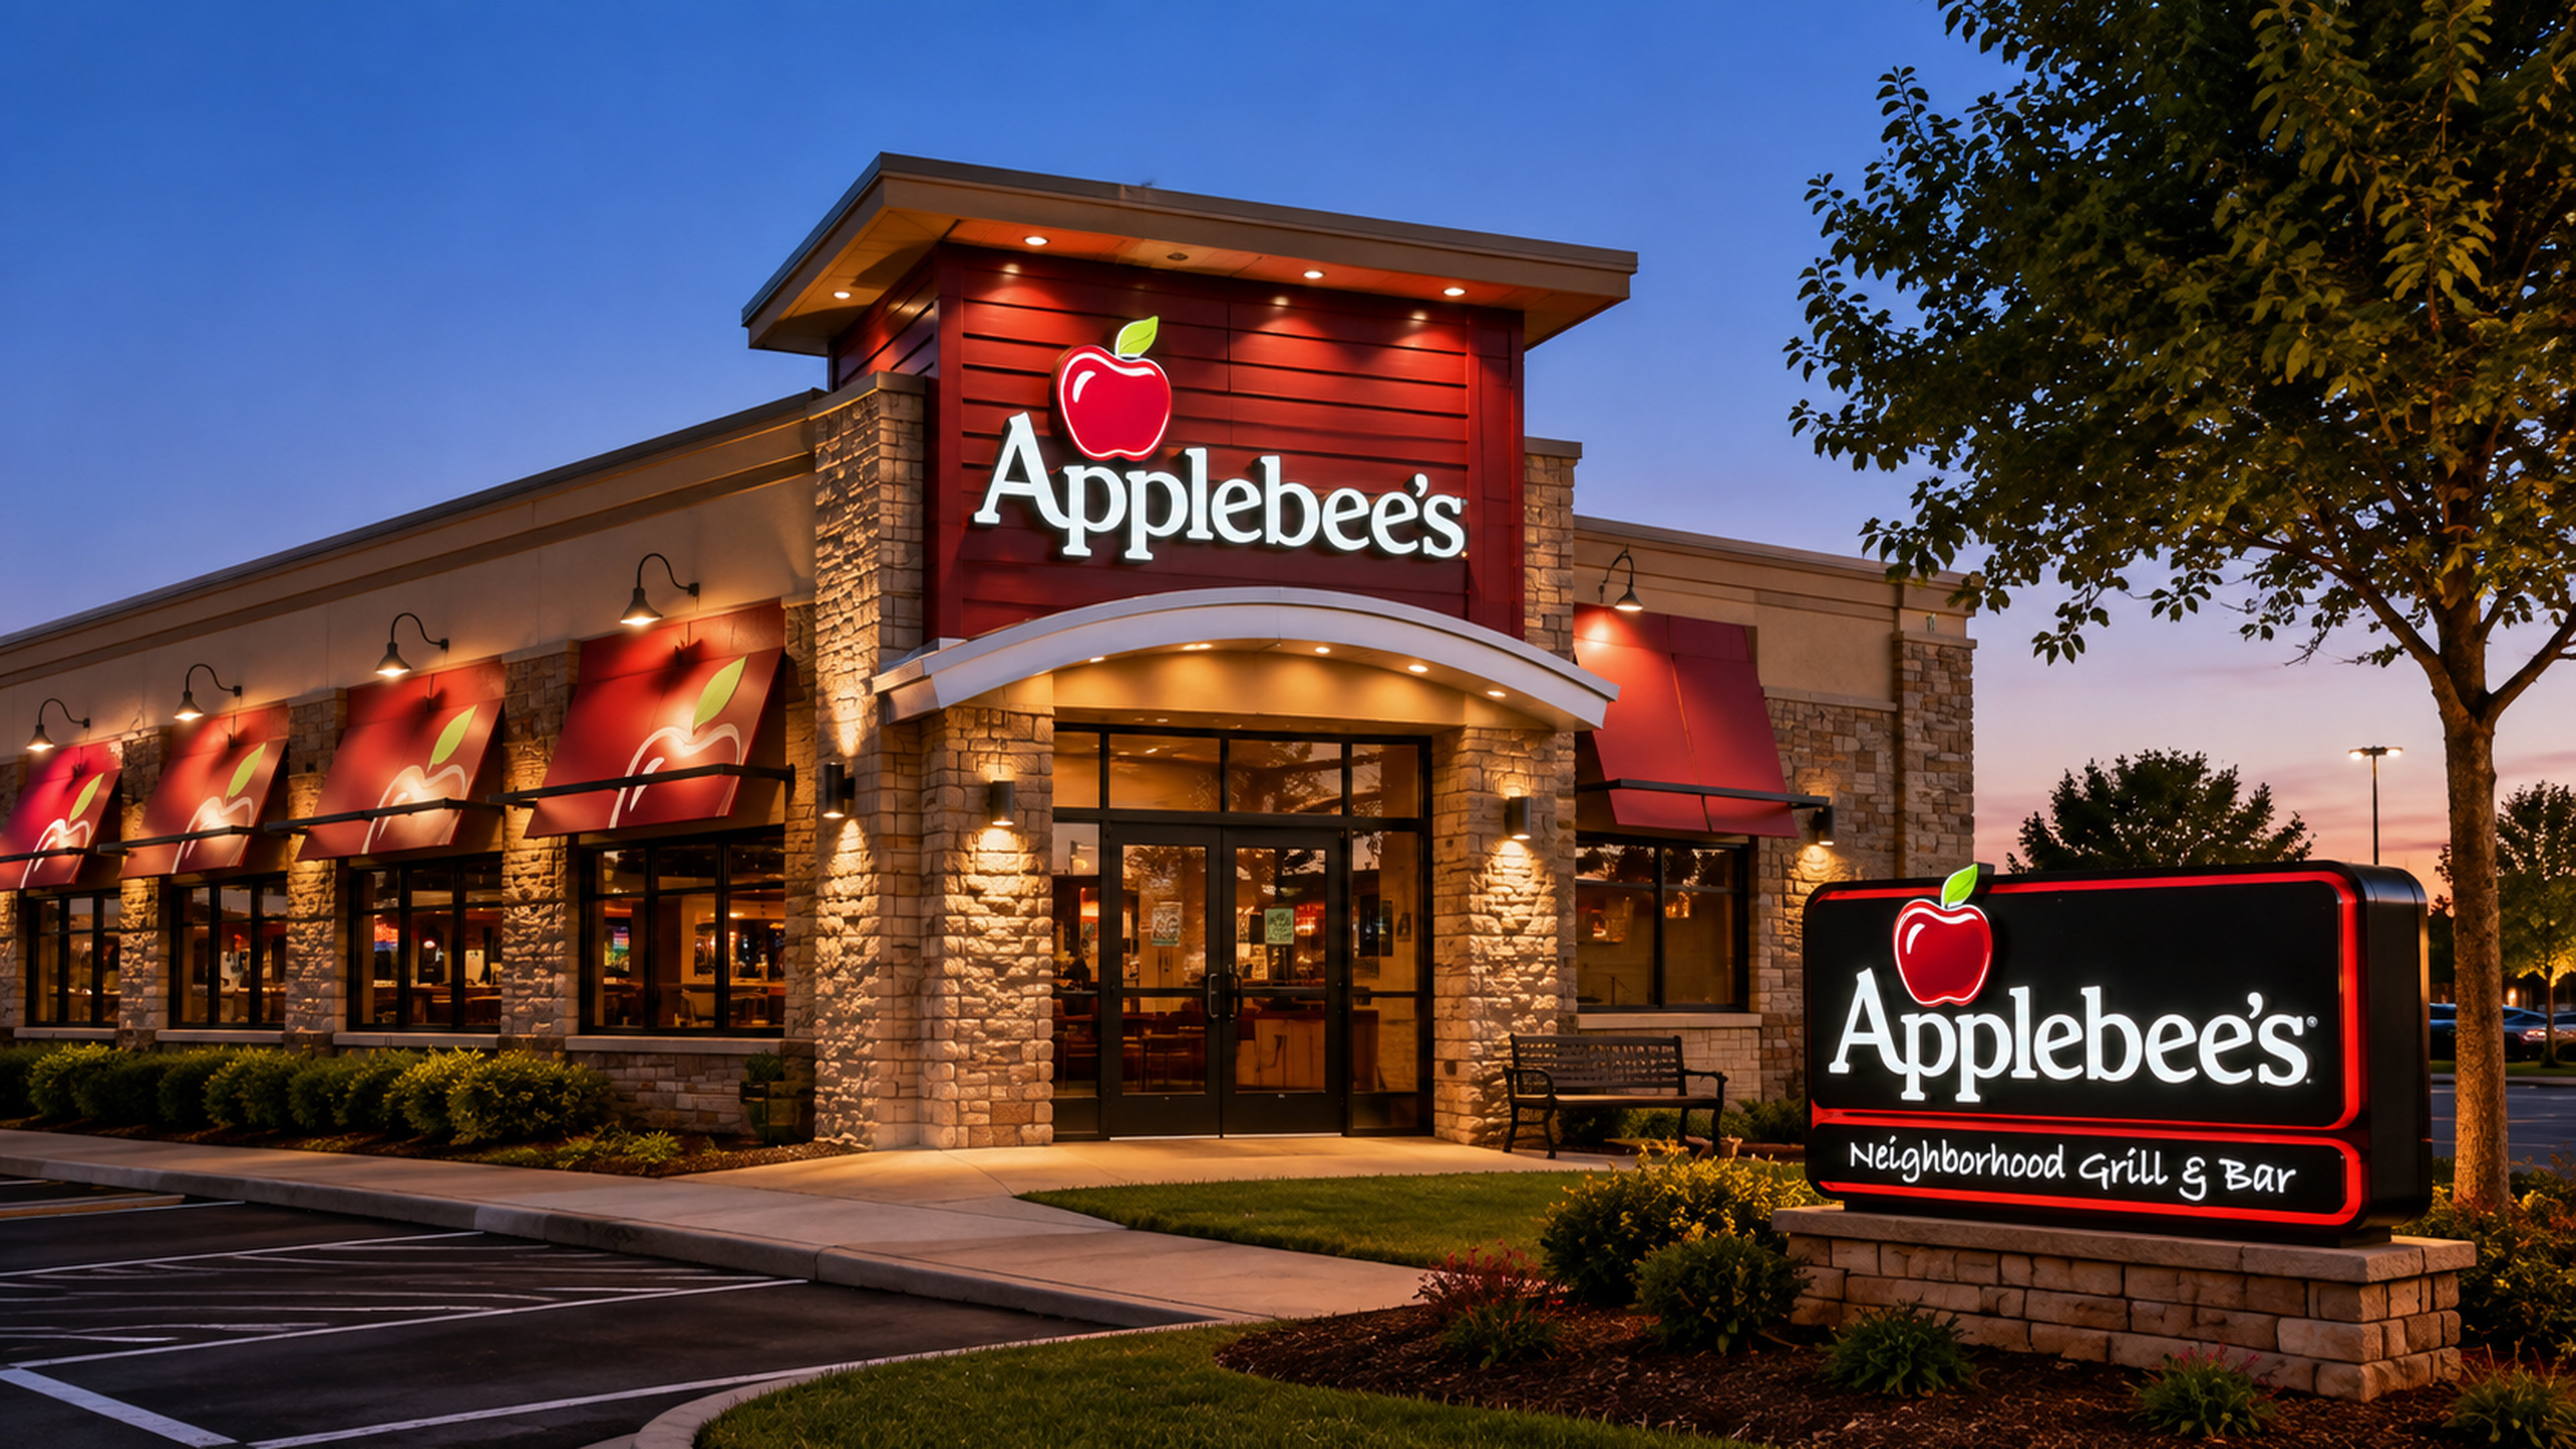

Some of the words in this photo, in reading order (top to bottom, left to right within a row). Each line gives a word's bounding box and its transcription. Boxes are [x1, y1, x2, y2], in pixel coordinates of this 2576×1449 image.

[973, 411, 1465, 561] Applebee's
[1828, 967, 2308, 1103] Applebee's
[1849, 1135, 2066, 1184] Neighborhood
[2078, 1147, 2169, 1191] Grill
[2178, 1156, 2207, 1201] &
[2218, 1158, 2297, 1193] Bar
